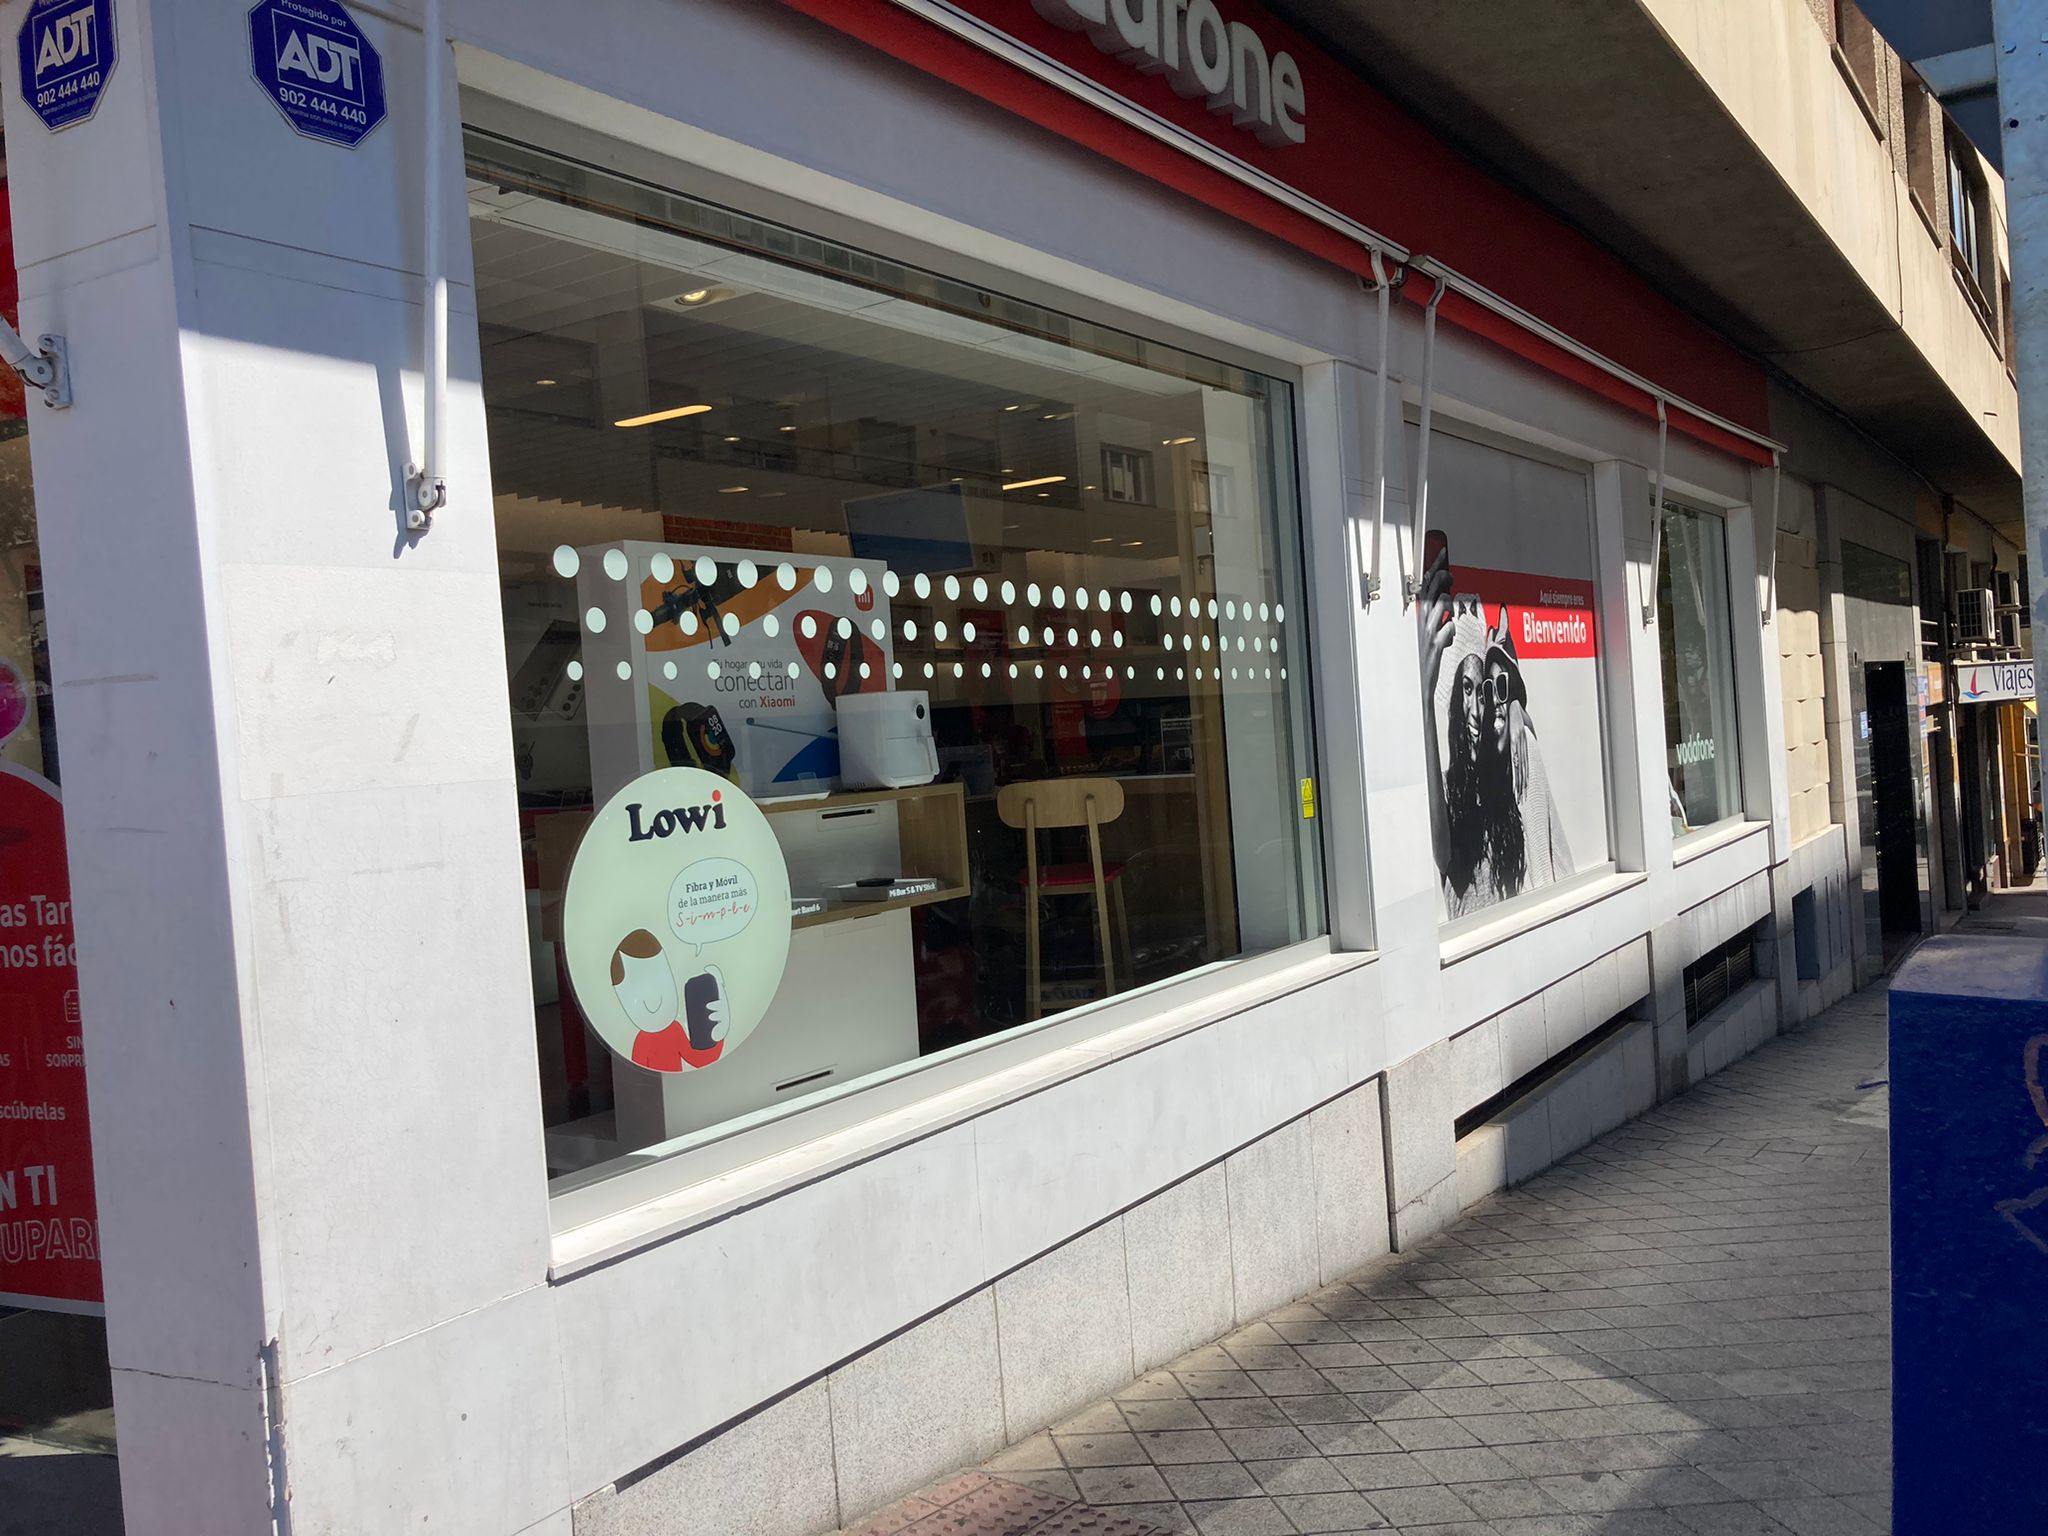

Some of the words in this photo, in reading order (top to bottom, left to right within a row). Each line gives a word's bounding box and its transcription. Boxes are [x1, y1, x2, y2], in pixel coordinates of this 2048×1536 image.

[281, 0, 329, 21] Protegido
[331, 16, 347, 27] por
[37, 4, 94, 75] ADT
[278, 30, 360, 91] ADT
[37, 88, 56, 107] 902
[58, 79, 78, 98] 444
[80, 71, 100, 90] 440
[279, 87, 307, 108] 902
[310, 97, 338, 116] 444
[341, 106, 367, 125] 440
[1522, 612, 1586, 644] Bienvenido
[724, 659, 747, 671] hogar
[768, 659, 783, 669] vida
[1992, 664, 2034, 696] Viajes
[714, 672, 794, 692] conectan
[739, 698, 757, 709] con
[760, 695, 795, 708] Xiaomi
[1676, 732, 1714, 765] vodafone
[625, 789, 727, 842] Lowi
[678, 898, 688, 908] de
[689, 896, 698, 907] la
[699, 891, 730, 905] manera
[685, 881, 708, 893] Fibra
[708, 881, 714, 891] y
[715, 874, 738, 888] Móvil
[0, 904, 27, 928] as
[30, 894, 70, 926] Tar
[24, 1165, 58, 1206] TI
[0, 1217, 101, 1263] UPAR
